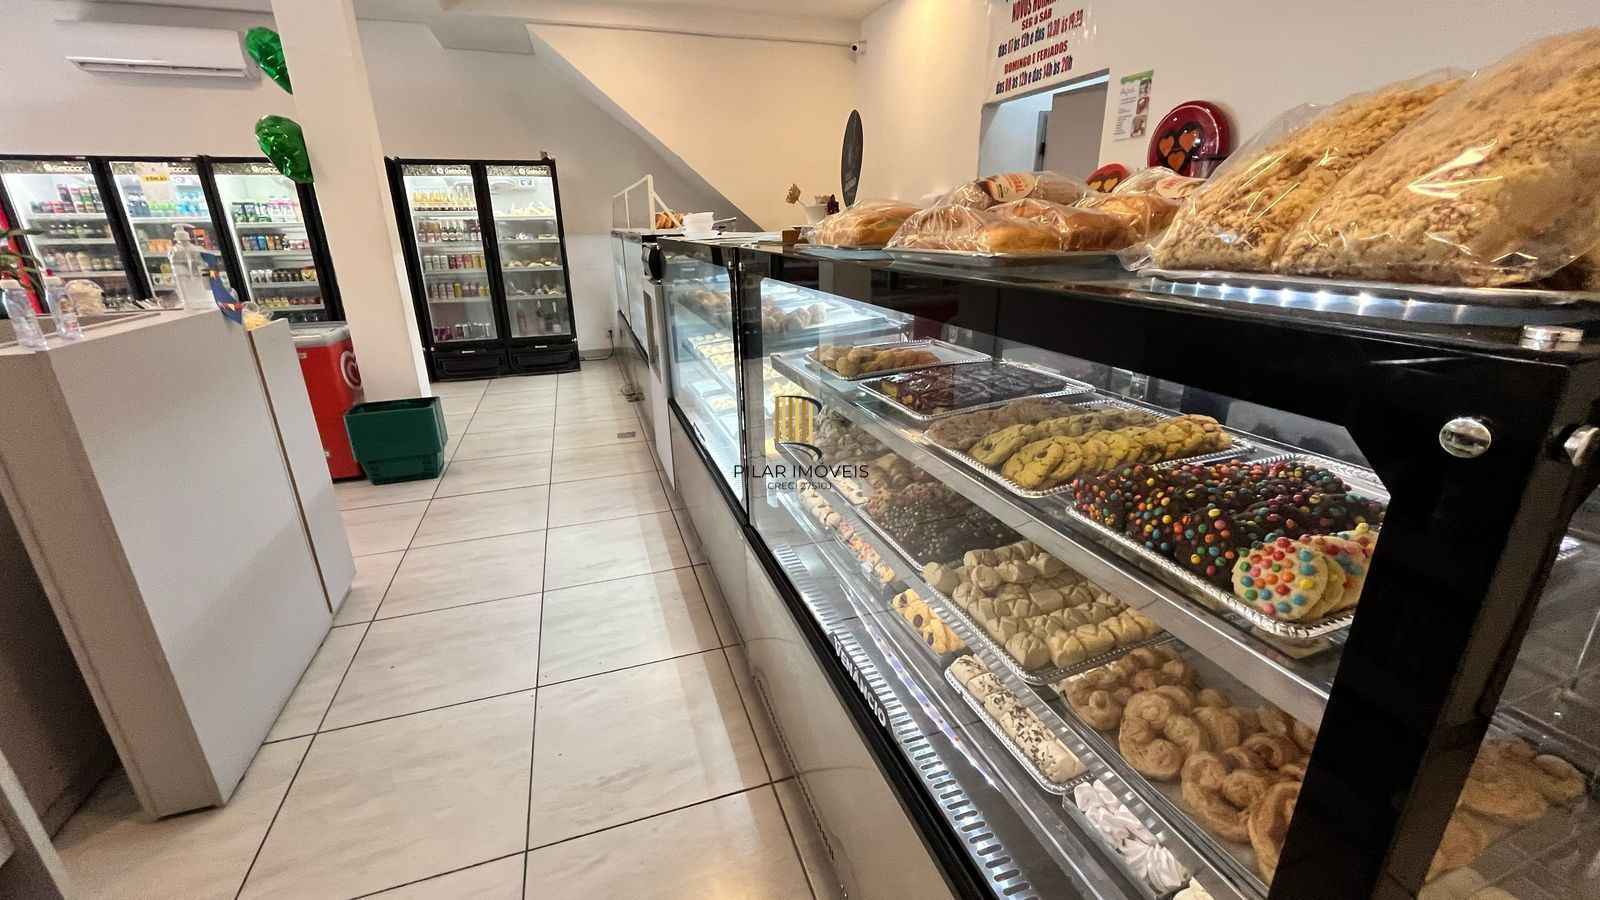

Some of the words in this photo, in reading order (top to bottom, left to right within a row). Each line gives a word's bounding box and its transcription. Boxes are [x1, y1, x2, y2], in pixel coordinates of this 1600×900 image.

[1021, 17, 1033, 31] SEG
[998, 43, 1008, 58] das
[1035, 26, 1045, 42] das
[1004, 54, 1031, 75] DOMINGO
[1032, 52, 1036, 65] E
[1037, 40, 1069, 62] FERIADOS
[996, 80, 1004, 95] das
[1032, 66, 1042, 83] das
